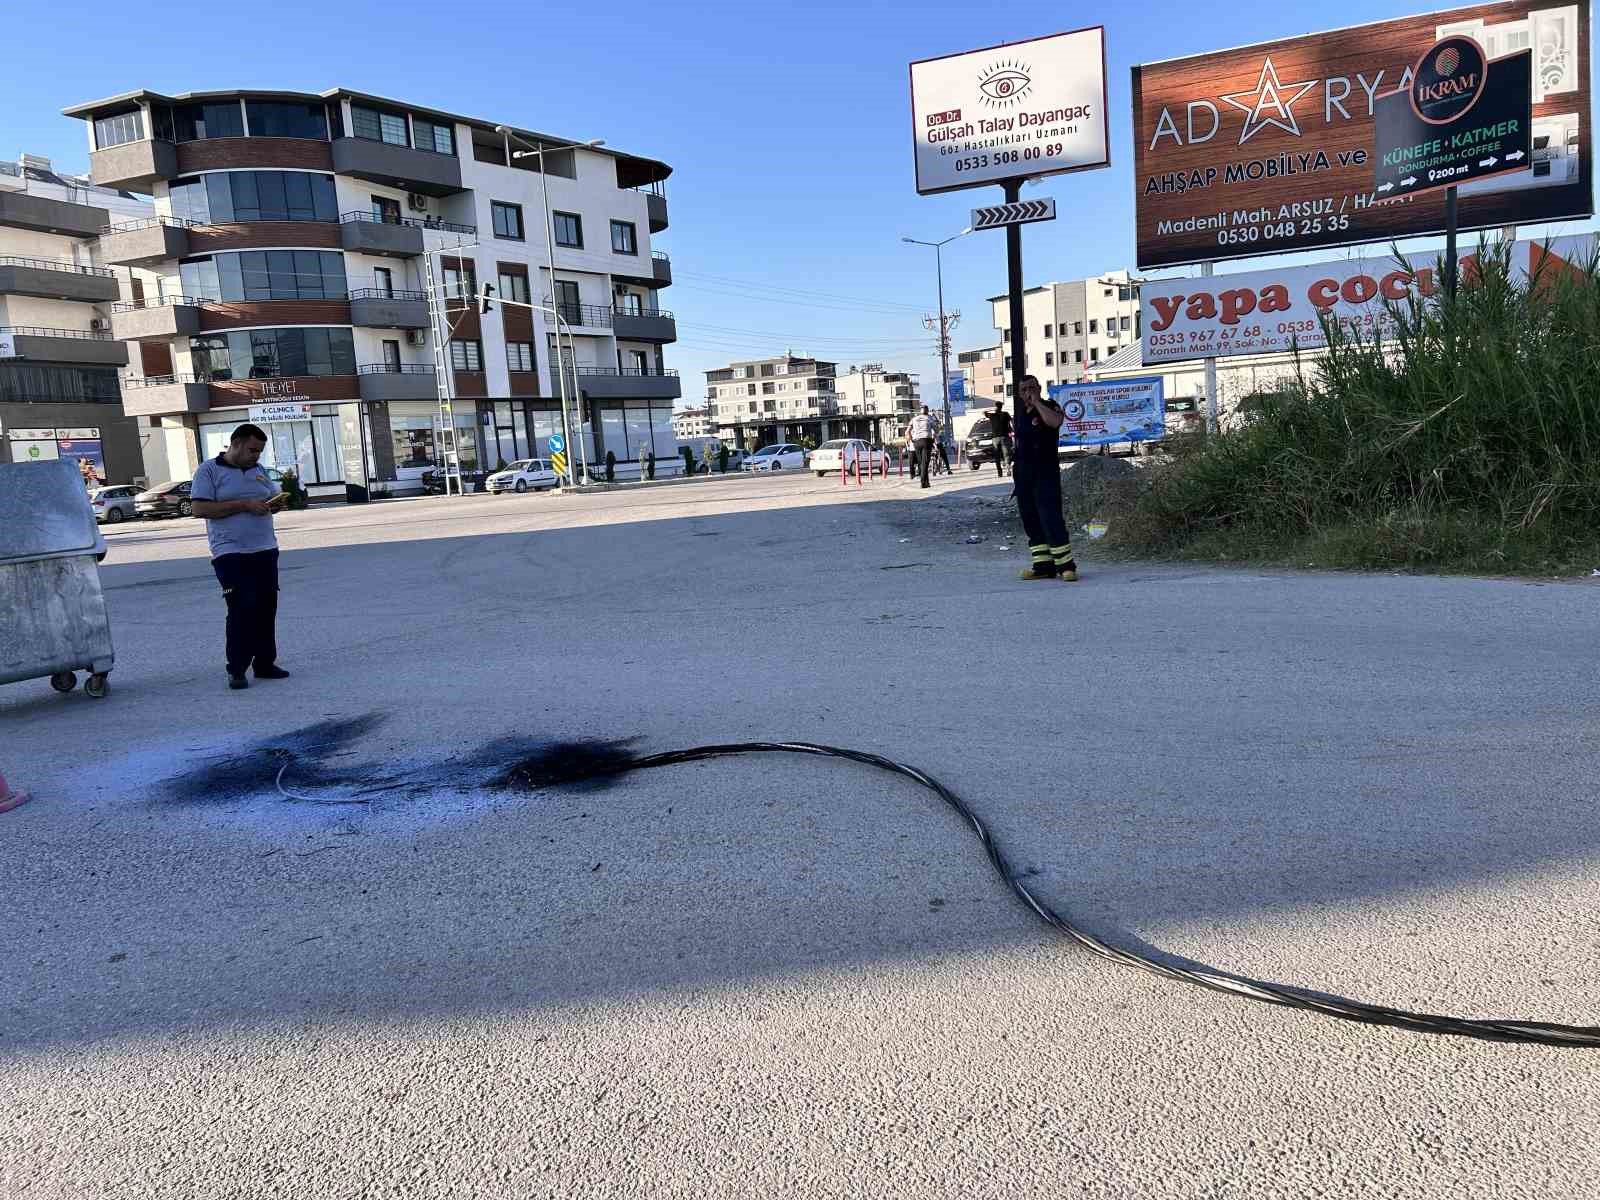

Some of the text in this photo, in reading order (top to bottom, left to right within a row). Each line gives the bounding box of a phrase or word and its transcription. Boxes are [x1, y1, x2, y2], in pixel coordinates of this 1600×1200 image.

[1419, 73, 1474, 101] İKRAM
[928, 111, 959, 125] Op. Dr.
[928, 104, 1090, 143] Gülşah Talay Dayangaç
[940, 125, 1078, 156] Göz Hastalıkları Uzmanı
[1383, 119, 1519, 166] KÜNEFE KATMER
[956, 143, 1063, 171] 0533 508 00 89
[1144, 150, 1367, 195] AHŞAP MOBİLYA ve
[1398, 141, 1501, 175] DONDURMA COFFEE
[1436, 165, 1469, 178] 200 mt
[1157, 213, 1227, 235] Madenli
[1218, 214, 1349, 245] 0530 048 25 35
[1149, 282, 1291, 331] yapa
[1150, 333, 1184, 346] 0533
[1190, 330, 1215, 342] 967
[1220, 327, 1238, 340] 67
[1243, 325, 1260, 338] 68
[1277, 319, 1315, 335] 0538
